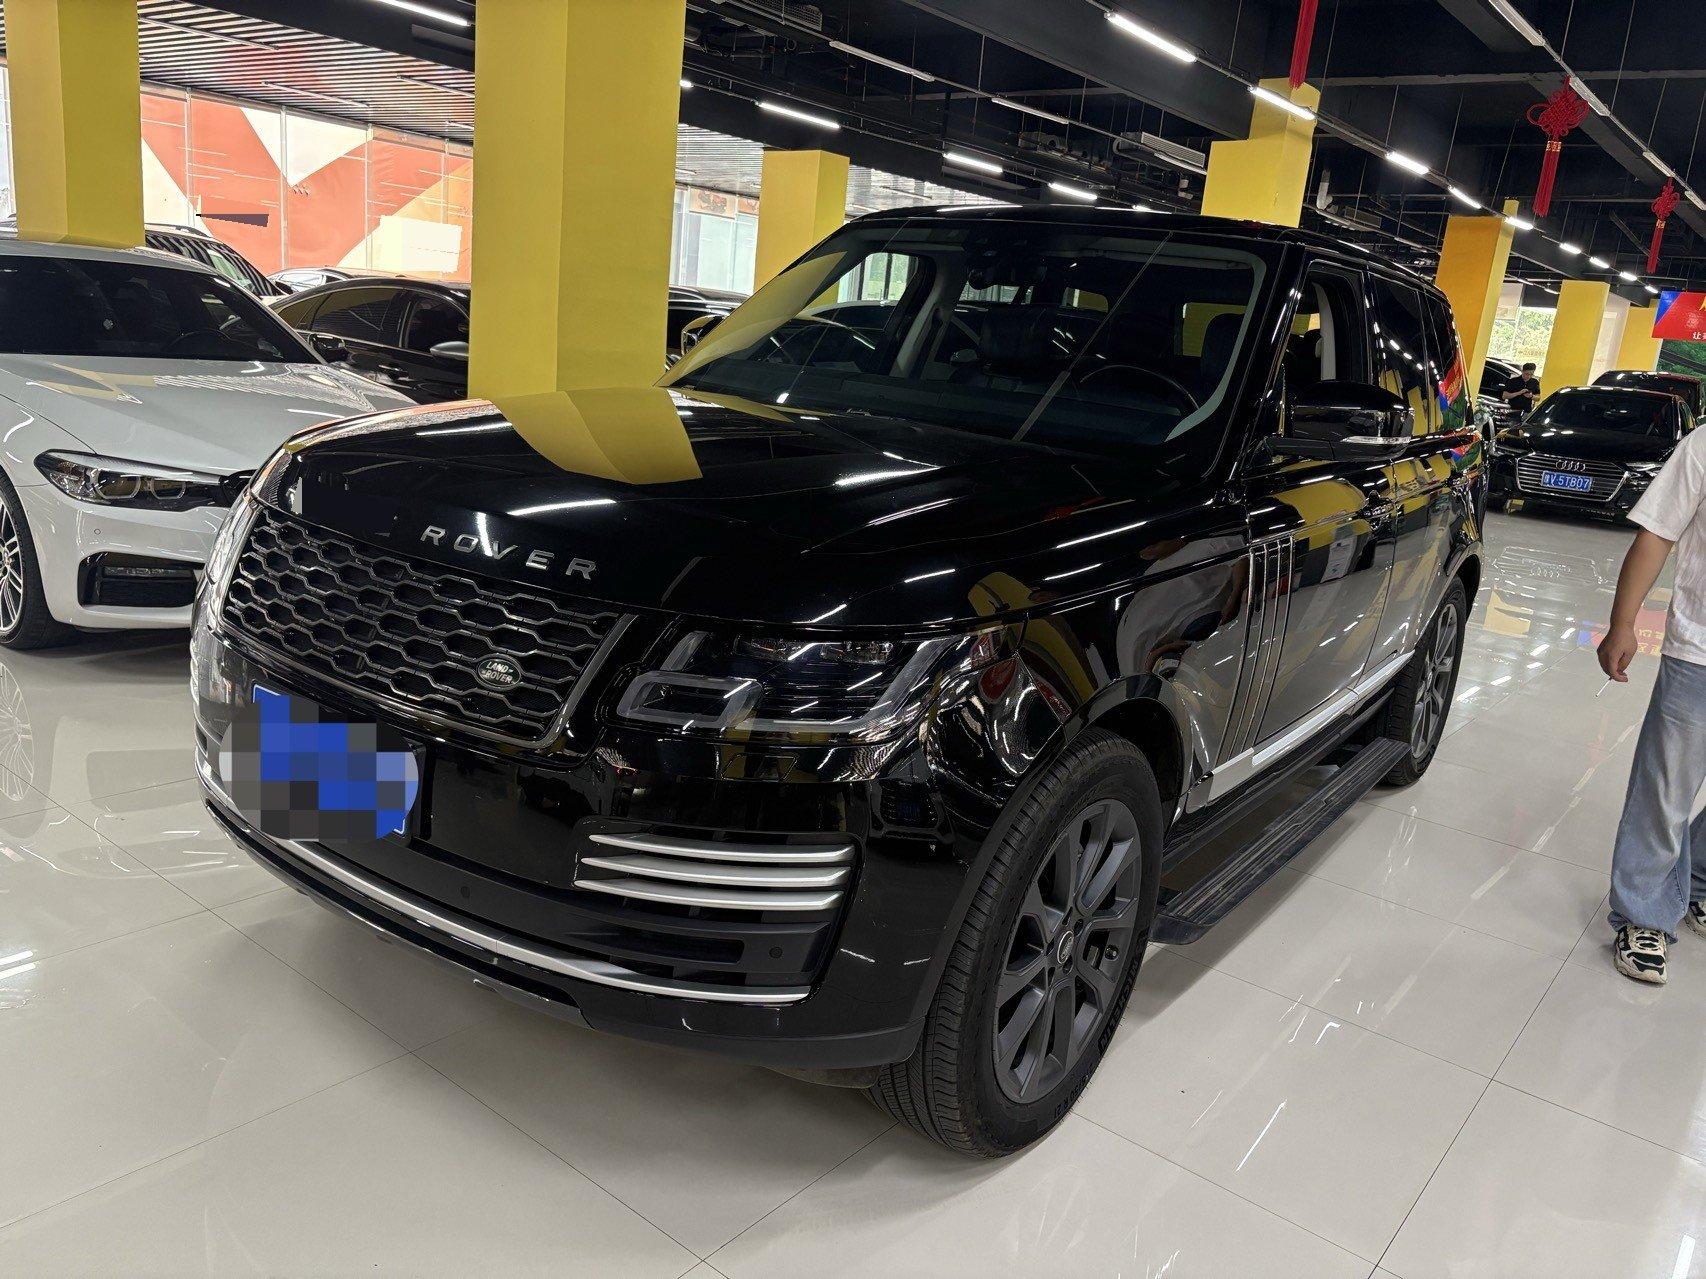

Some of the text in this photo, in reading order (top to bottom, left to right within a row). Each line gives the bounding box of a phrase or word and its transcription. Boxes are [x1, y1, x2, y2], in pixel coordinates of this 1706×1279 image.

[419, 524, 598, 581] ROVER
[485, 661, 509, 673] LAND
[484, 669, 513, 684] ROVER
